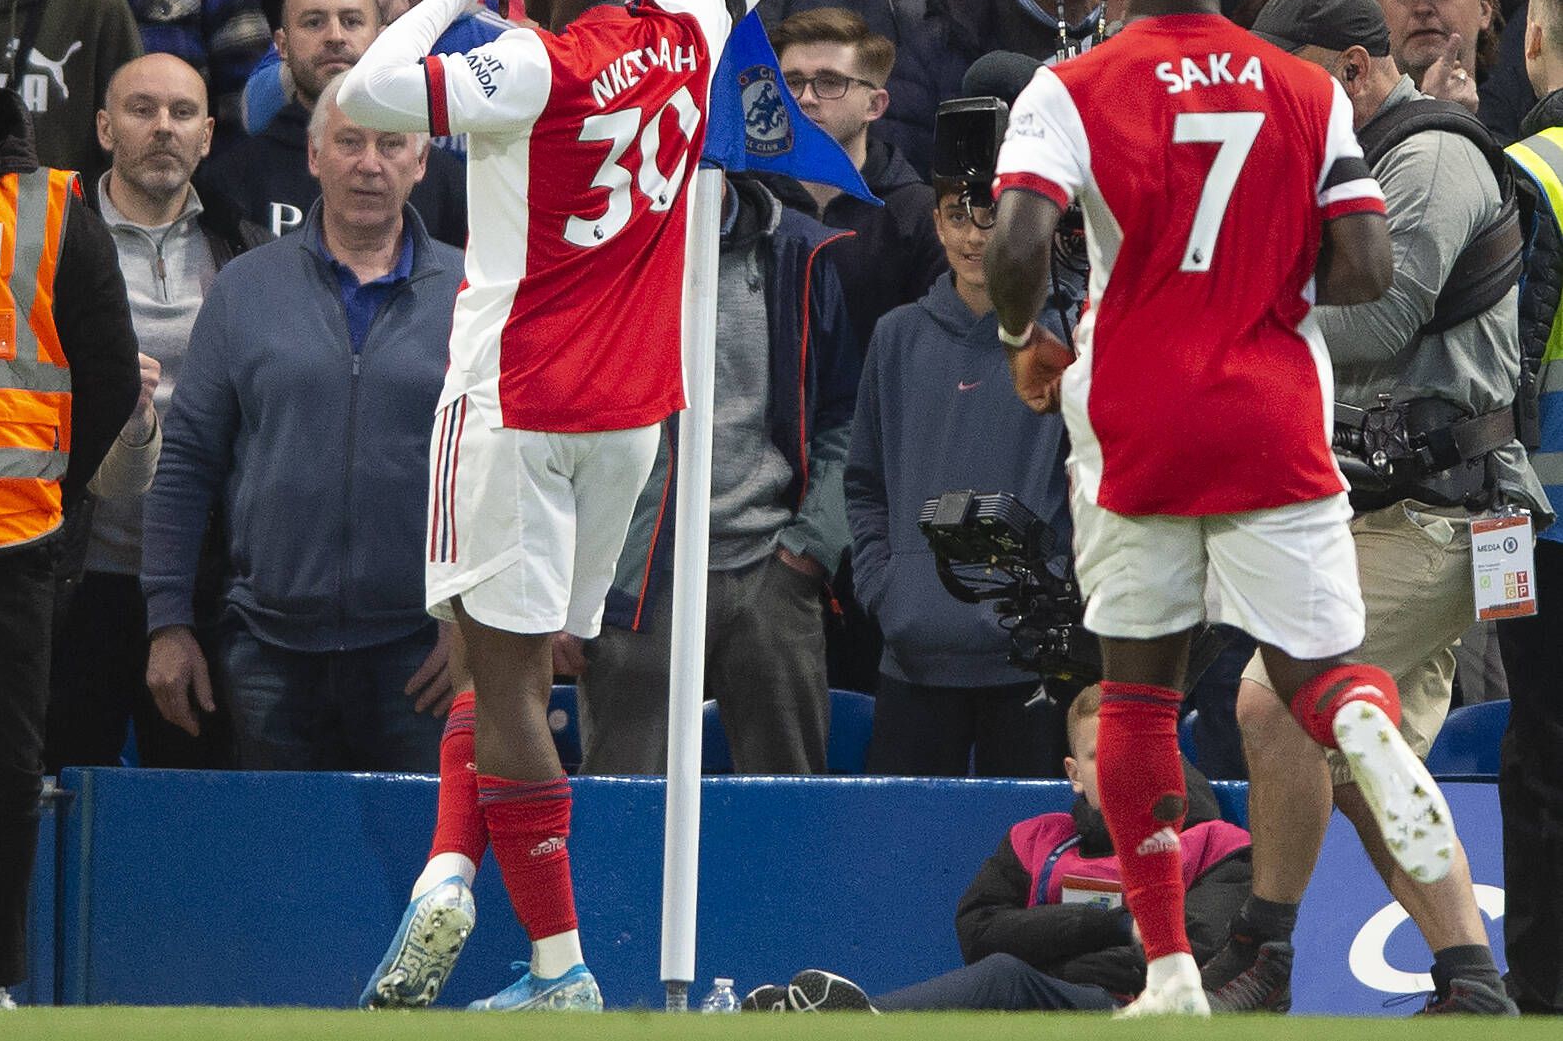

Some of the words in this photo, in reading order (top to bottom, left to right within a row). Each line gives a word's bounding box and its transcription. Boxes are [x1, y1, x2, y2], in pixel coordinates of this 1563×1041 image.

[466, 55, 498, 99] ANDA
[591, 37, 698, 108] NKETIAH
[1154, 52, 1266, 95] SAKA
[563, 85, 702, 248] 30
[1171, 111, 1267, 273] 7
[1477, 543, 1502, 553] MEDIA
